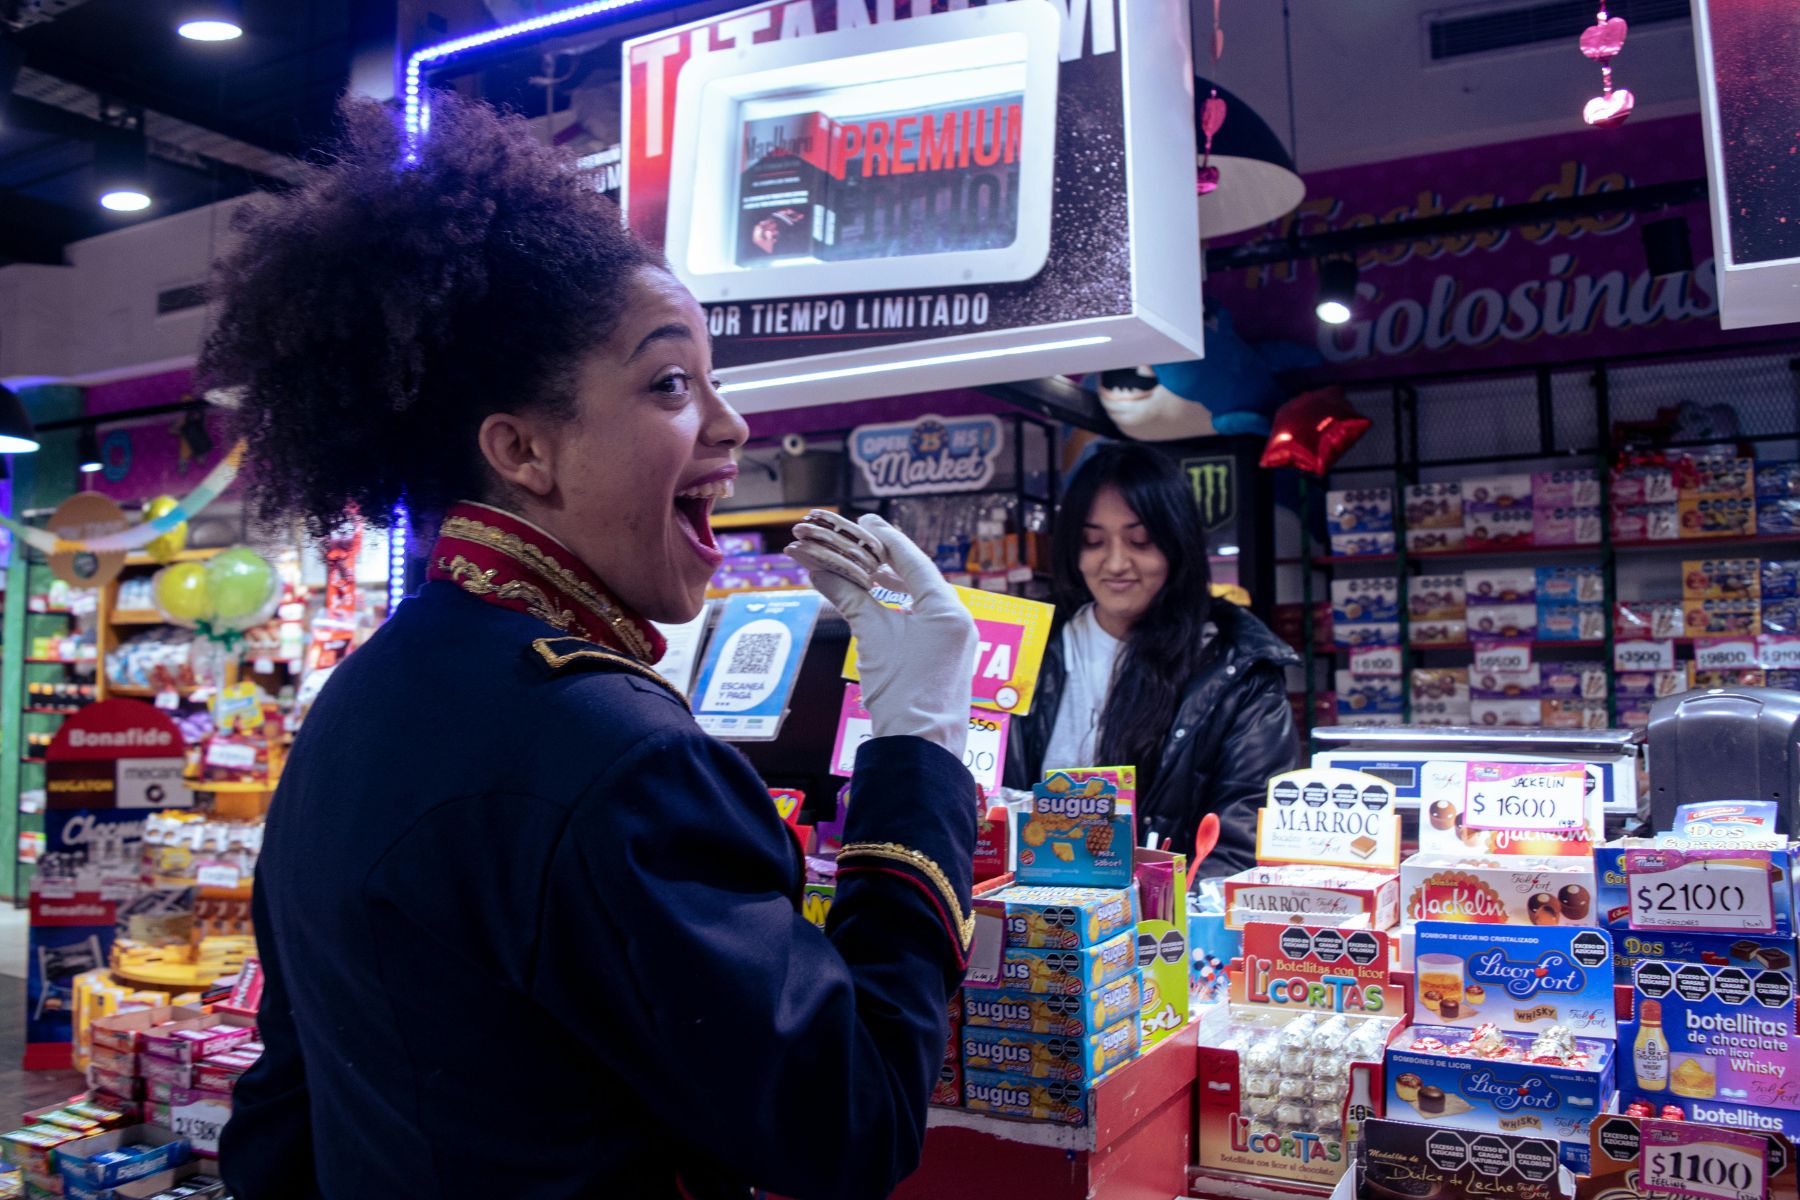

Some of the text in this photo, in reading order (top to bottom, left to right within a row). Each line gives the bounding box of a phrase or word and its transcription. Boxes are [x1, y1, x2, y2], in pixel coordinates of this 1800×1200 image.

[703, 292, 989, 336] OR TIEMPO LIMITADO
[1315, 253, 1719, 365] Golosinas
[862, 434, 910, 455] OPEN
[871, 448, 985, 488] Market
[972, 640, 1012, 680] TA
[67, 729, 172, 747] Bonafide
[125, 766, 183, 779] mecan
[1036, 797, 1111, 818] sugus
[1473, 792, 1556, 818] $ 1600
[1274, 809, 1380, 836] MARROC
[1684, 823, 1745, 838] Dos
[1242, 893, 1311, 913] MARROC
[1637, 882, 1745, 914] $2100
[1490, 936, 1539, 944] CRISTALIZADO
[1624, 938, 1664, 955] Dos
[1276, 960, 1385, 979] Botellitas con licor
[966, 1001, 1031, 1021] sugus
[1515, 1007, 1555, 1021] WHISKY
[1685, 1009, 1789, 1037] botellitas
[966, 1041, 1032, 1063] sugus
[1687, 1031, 1789, 1052] de chocolate
[1392, 1055, 1472, 1070] BOMBONES DE LICOR
[1704, 1046, 1755, 1059] con licor
[1729, 1058, 1786, 1079] Whisky
[965, 1082, 1031, 1107] sugus
[1500, 1117, 1540, 1129] WHISKY
[1692, 1104, 1784, 1131] botellitas
[1602, 1131, 1629, 1140] EXCESO
[1430, 1143, 1454, 1151] EXCESO
[1473, 1145, 1496, 1153] EXCESO
[1516, 1153, 1540, 1161] EXCESO
[1377, 1162, 1514, 1195] Dulce de Leche
[1651, 1151, 1752, 1190] $1100
